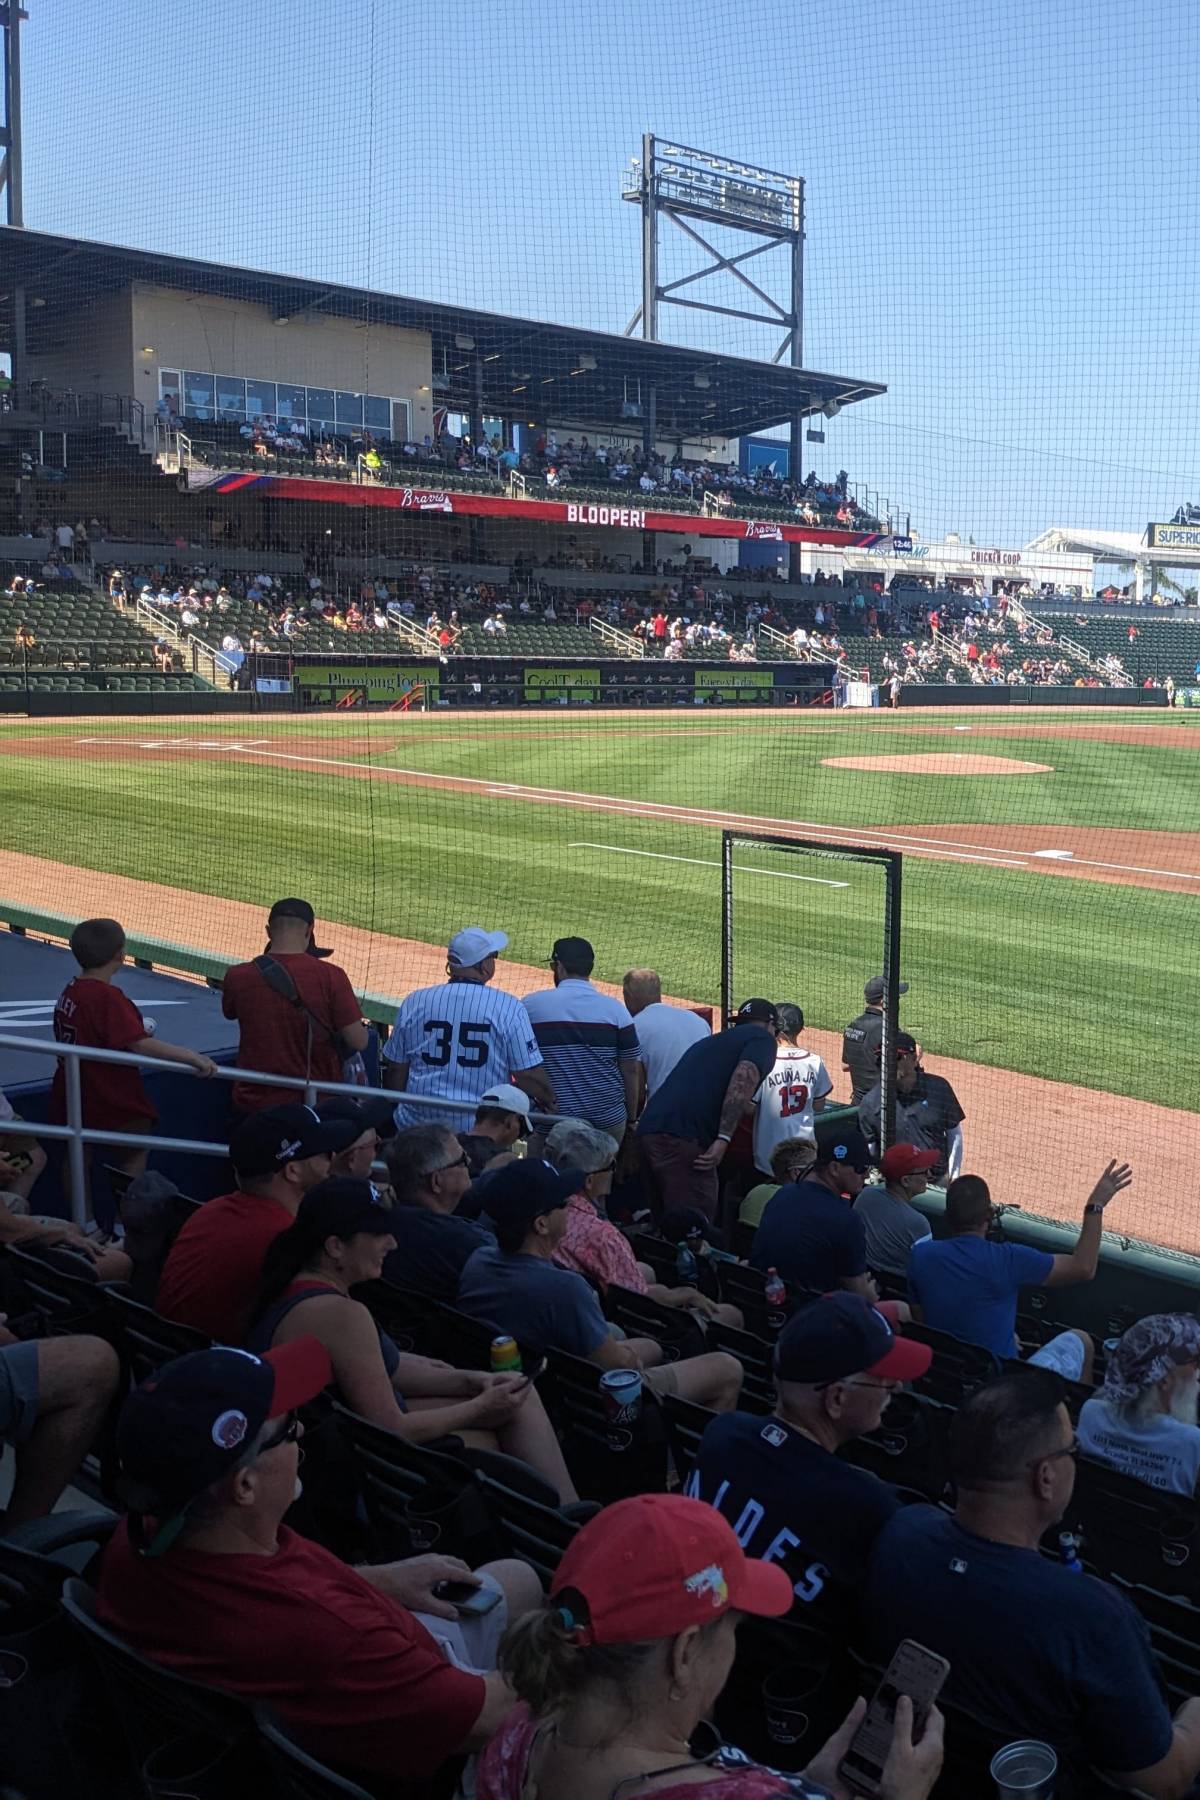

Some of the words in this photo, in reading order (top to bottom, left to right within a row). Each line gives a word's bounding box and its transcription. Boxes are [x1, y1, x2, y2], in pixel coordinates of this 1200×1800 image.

[567, 505, 646, 528] BLOOPER!
[971, 551, 1001, 564] CHICKEN
[1003, 552, 1021, 565] COOP
[421, 1020, 491, 1068] 35
[778, 1084, 809, 1118] 13
